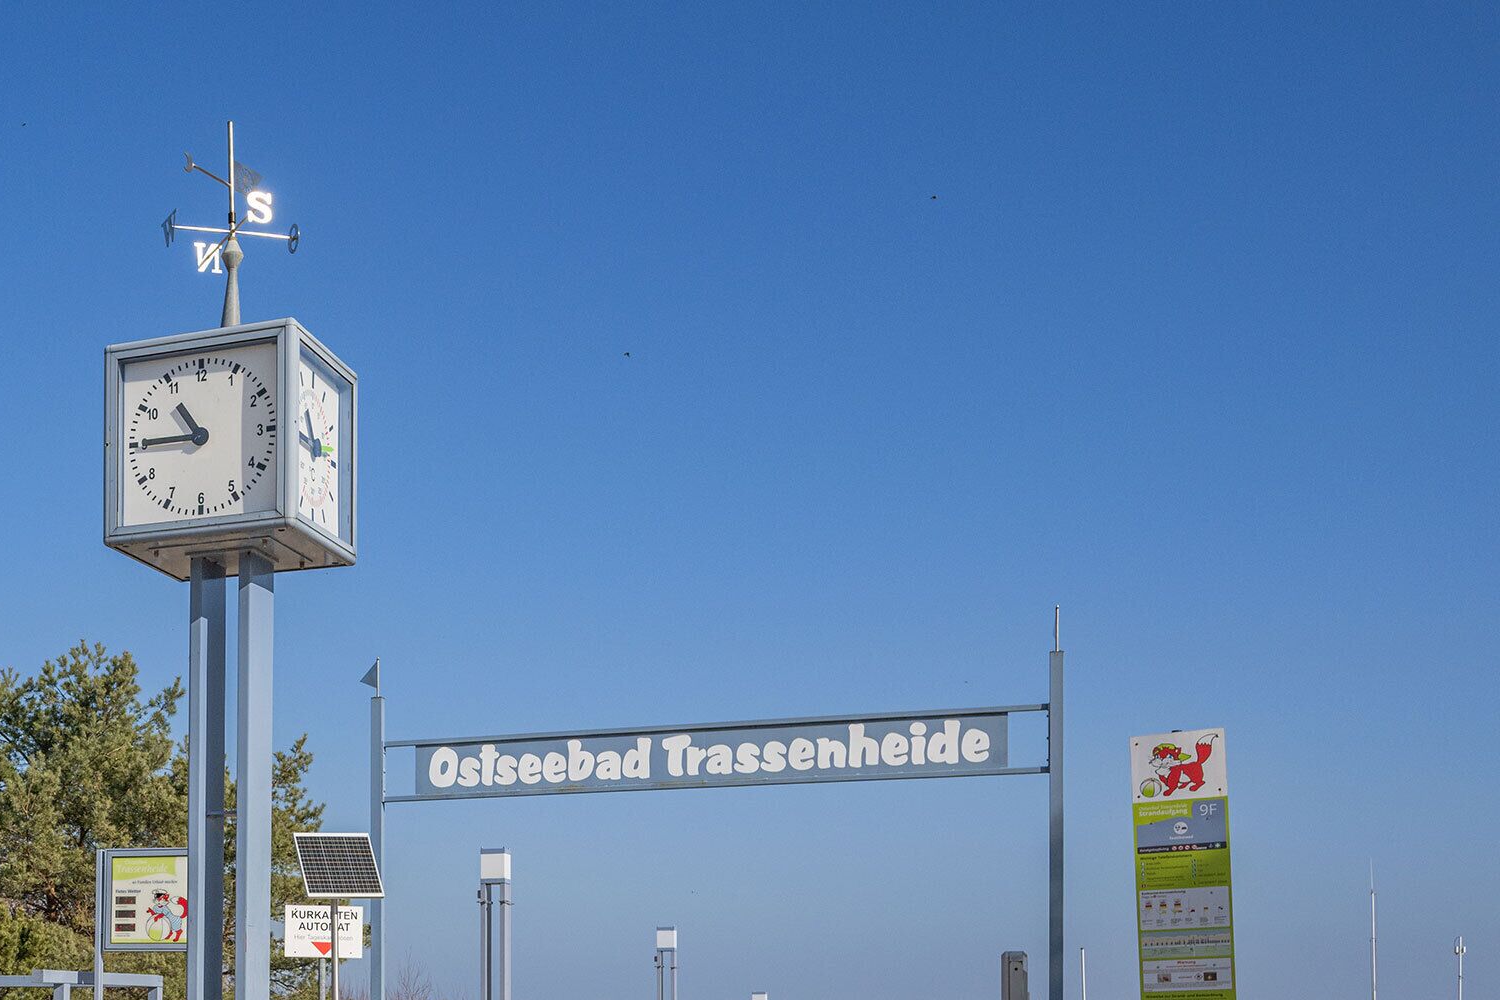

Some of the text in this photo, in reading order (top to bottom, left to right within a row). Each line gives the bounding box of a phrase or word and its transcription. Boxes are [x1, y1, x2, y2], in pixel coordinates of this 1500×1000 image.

[247, 190, 273, 224] S
[195, 369, 207, 382] 12
[227, 374, 234, 386] 1
[168, 382, 179, 394] 11
[250, 395, 257, 407] 2
[146, 408, 158, 420] 10
[256, 424, 264, 436] 3
[248, 456, 255, 469] 4
[148, 467, 156, 480] 8
[228, 480, 235, 492] 5
[169, 486, 176, 499] 7
[197, 493, 205, 505] 6
[429, 719, 991, 789] Ostseebad Trassenheide
[1199, 803, 1217, 816] 9F
[291, 910, 358, 920] KURKATEN
